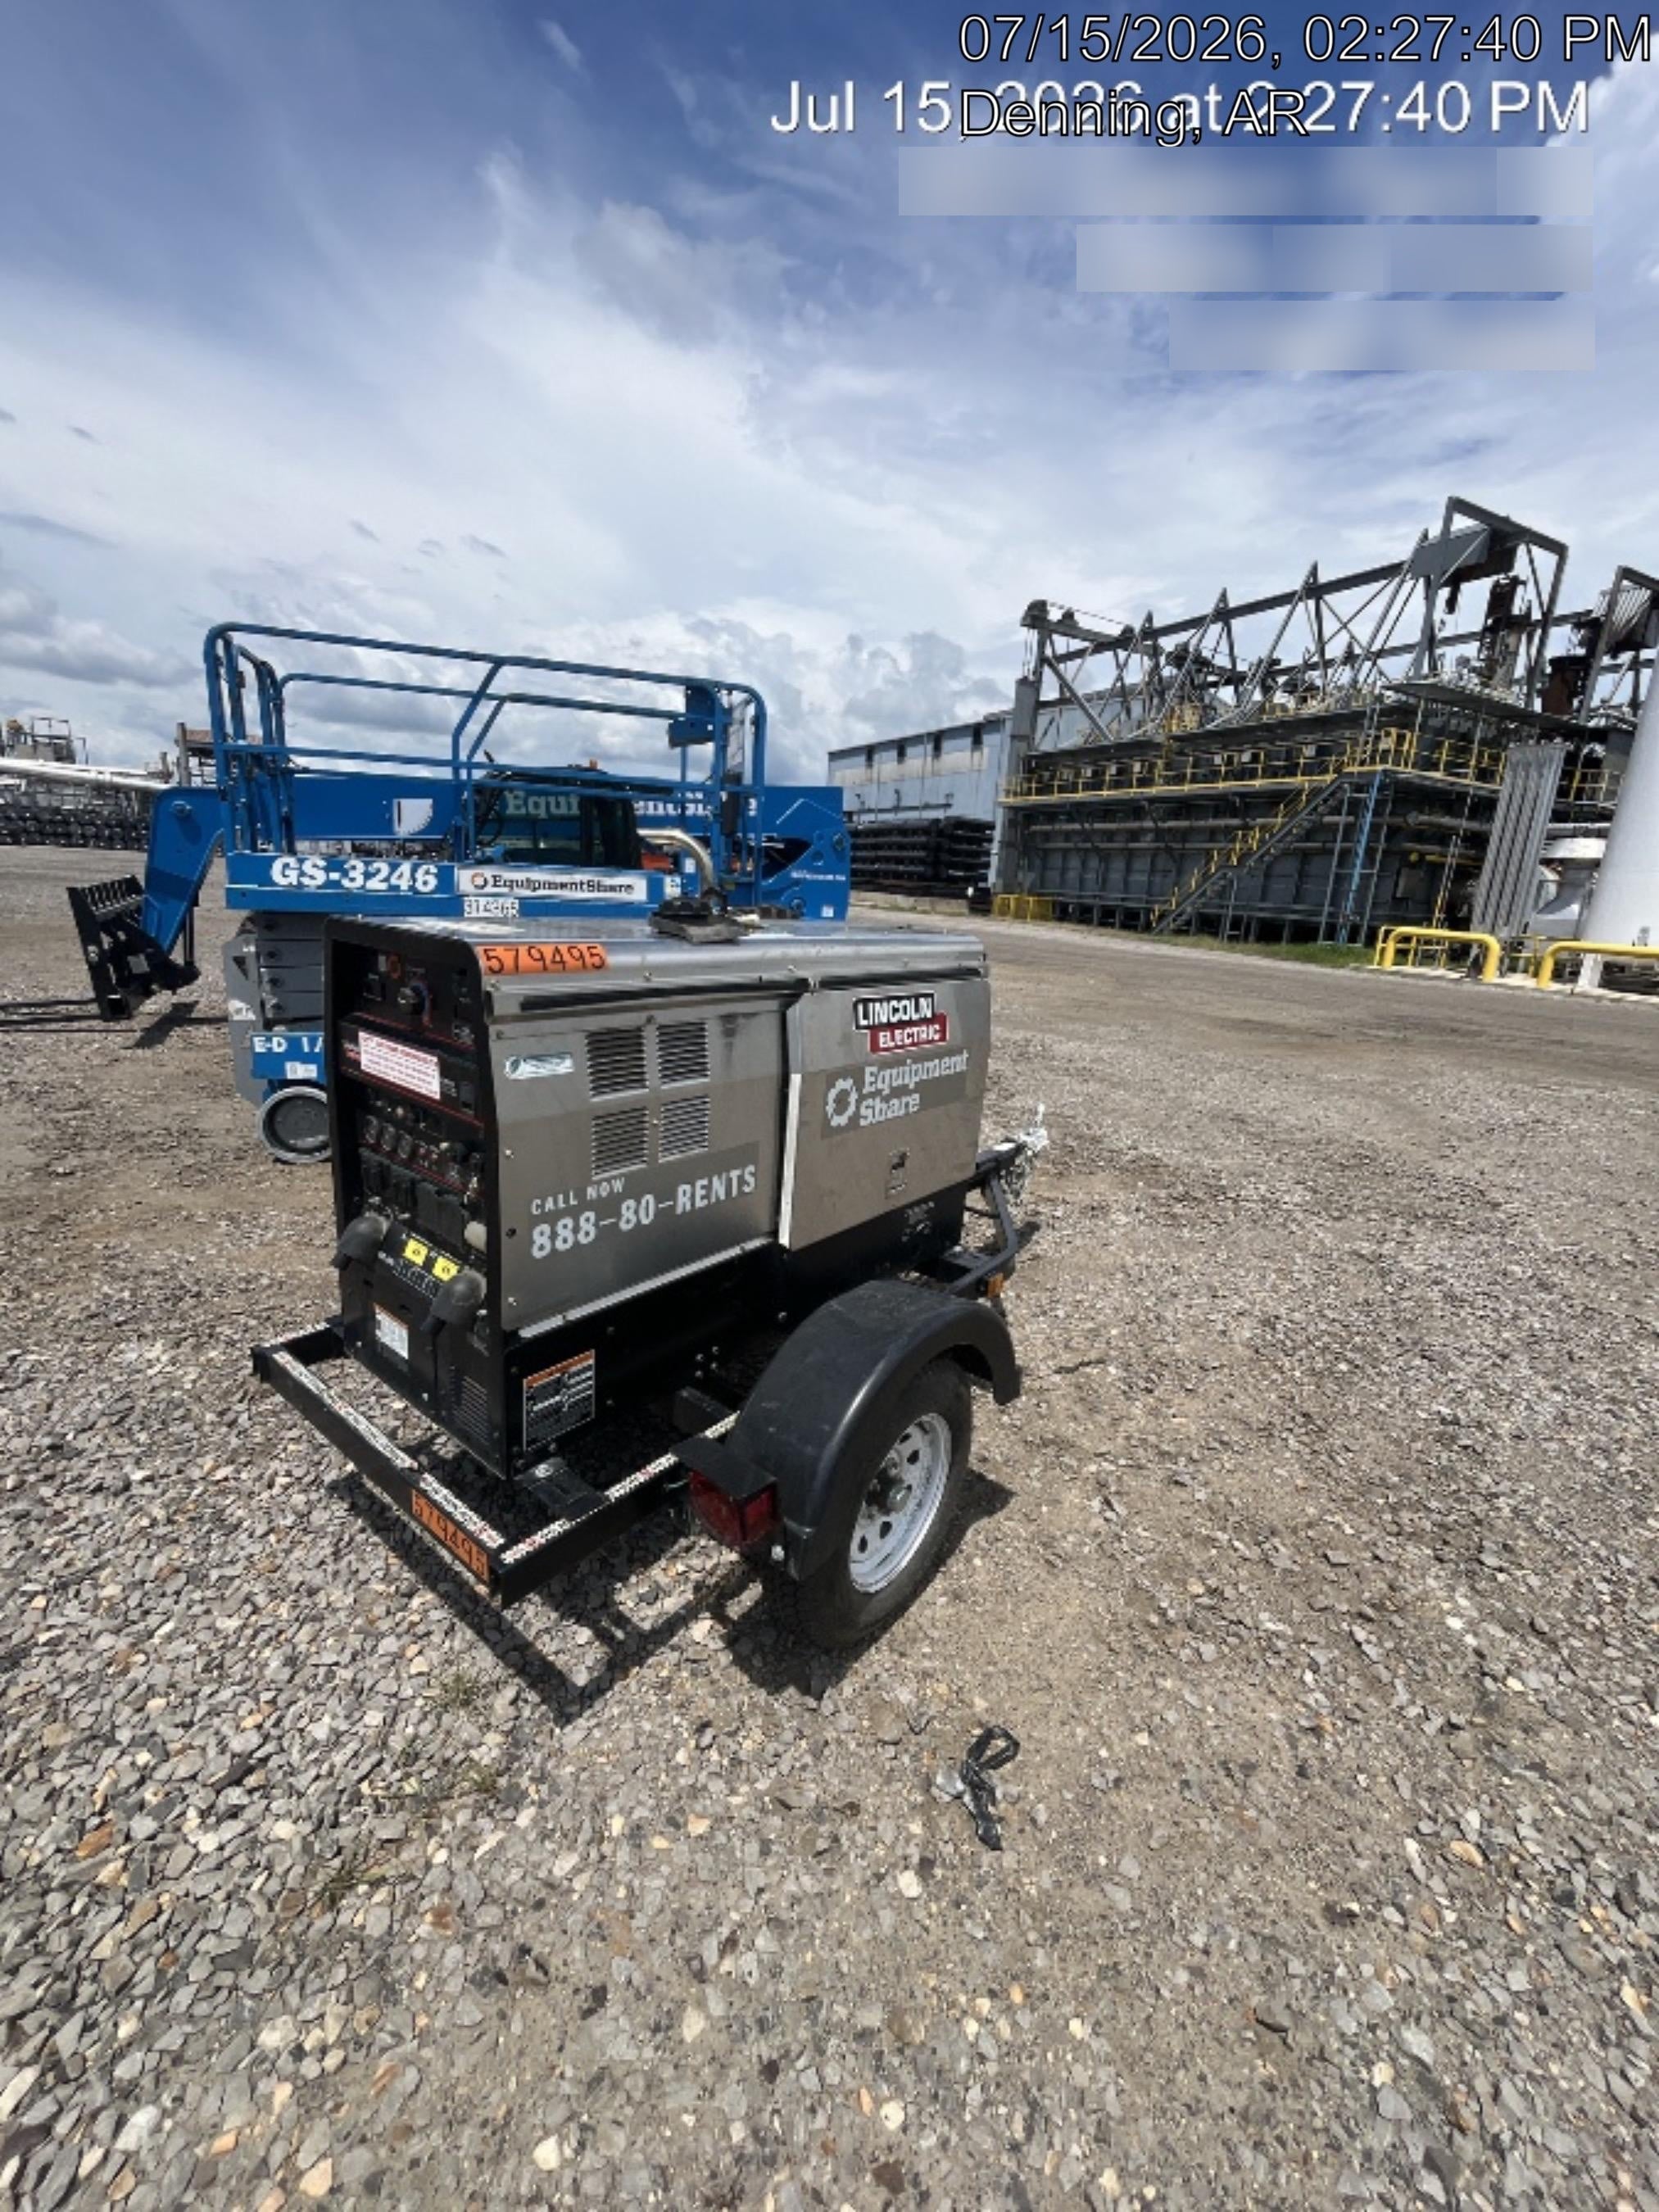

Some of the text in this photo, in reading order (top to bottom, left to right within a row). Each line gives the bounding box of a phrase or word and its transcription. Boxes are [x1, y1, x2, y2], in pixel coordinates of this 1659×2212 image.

[270, 856, 438, 893] GS-3246
[491, 874, 635, 895] EquipmentShare
[483, 945, 605, 974] 579495
[858, 997, 933, 1026] LINCOLN
[879, 1024, 941, 1048] ELECTRIC
[862, 1049, 969, 1095] Equipment
[859, 1093, 920, 1126] Share
[531, 1177, 625, 1214] CALL NOW
[532, 1164, 755, 1258] 888-80-RENTS
